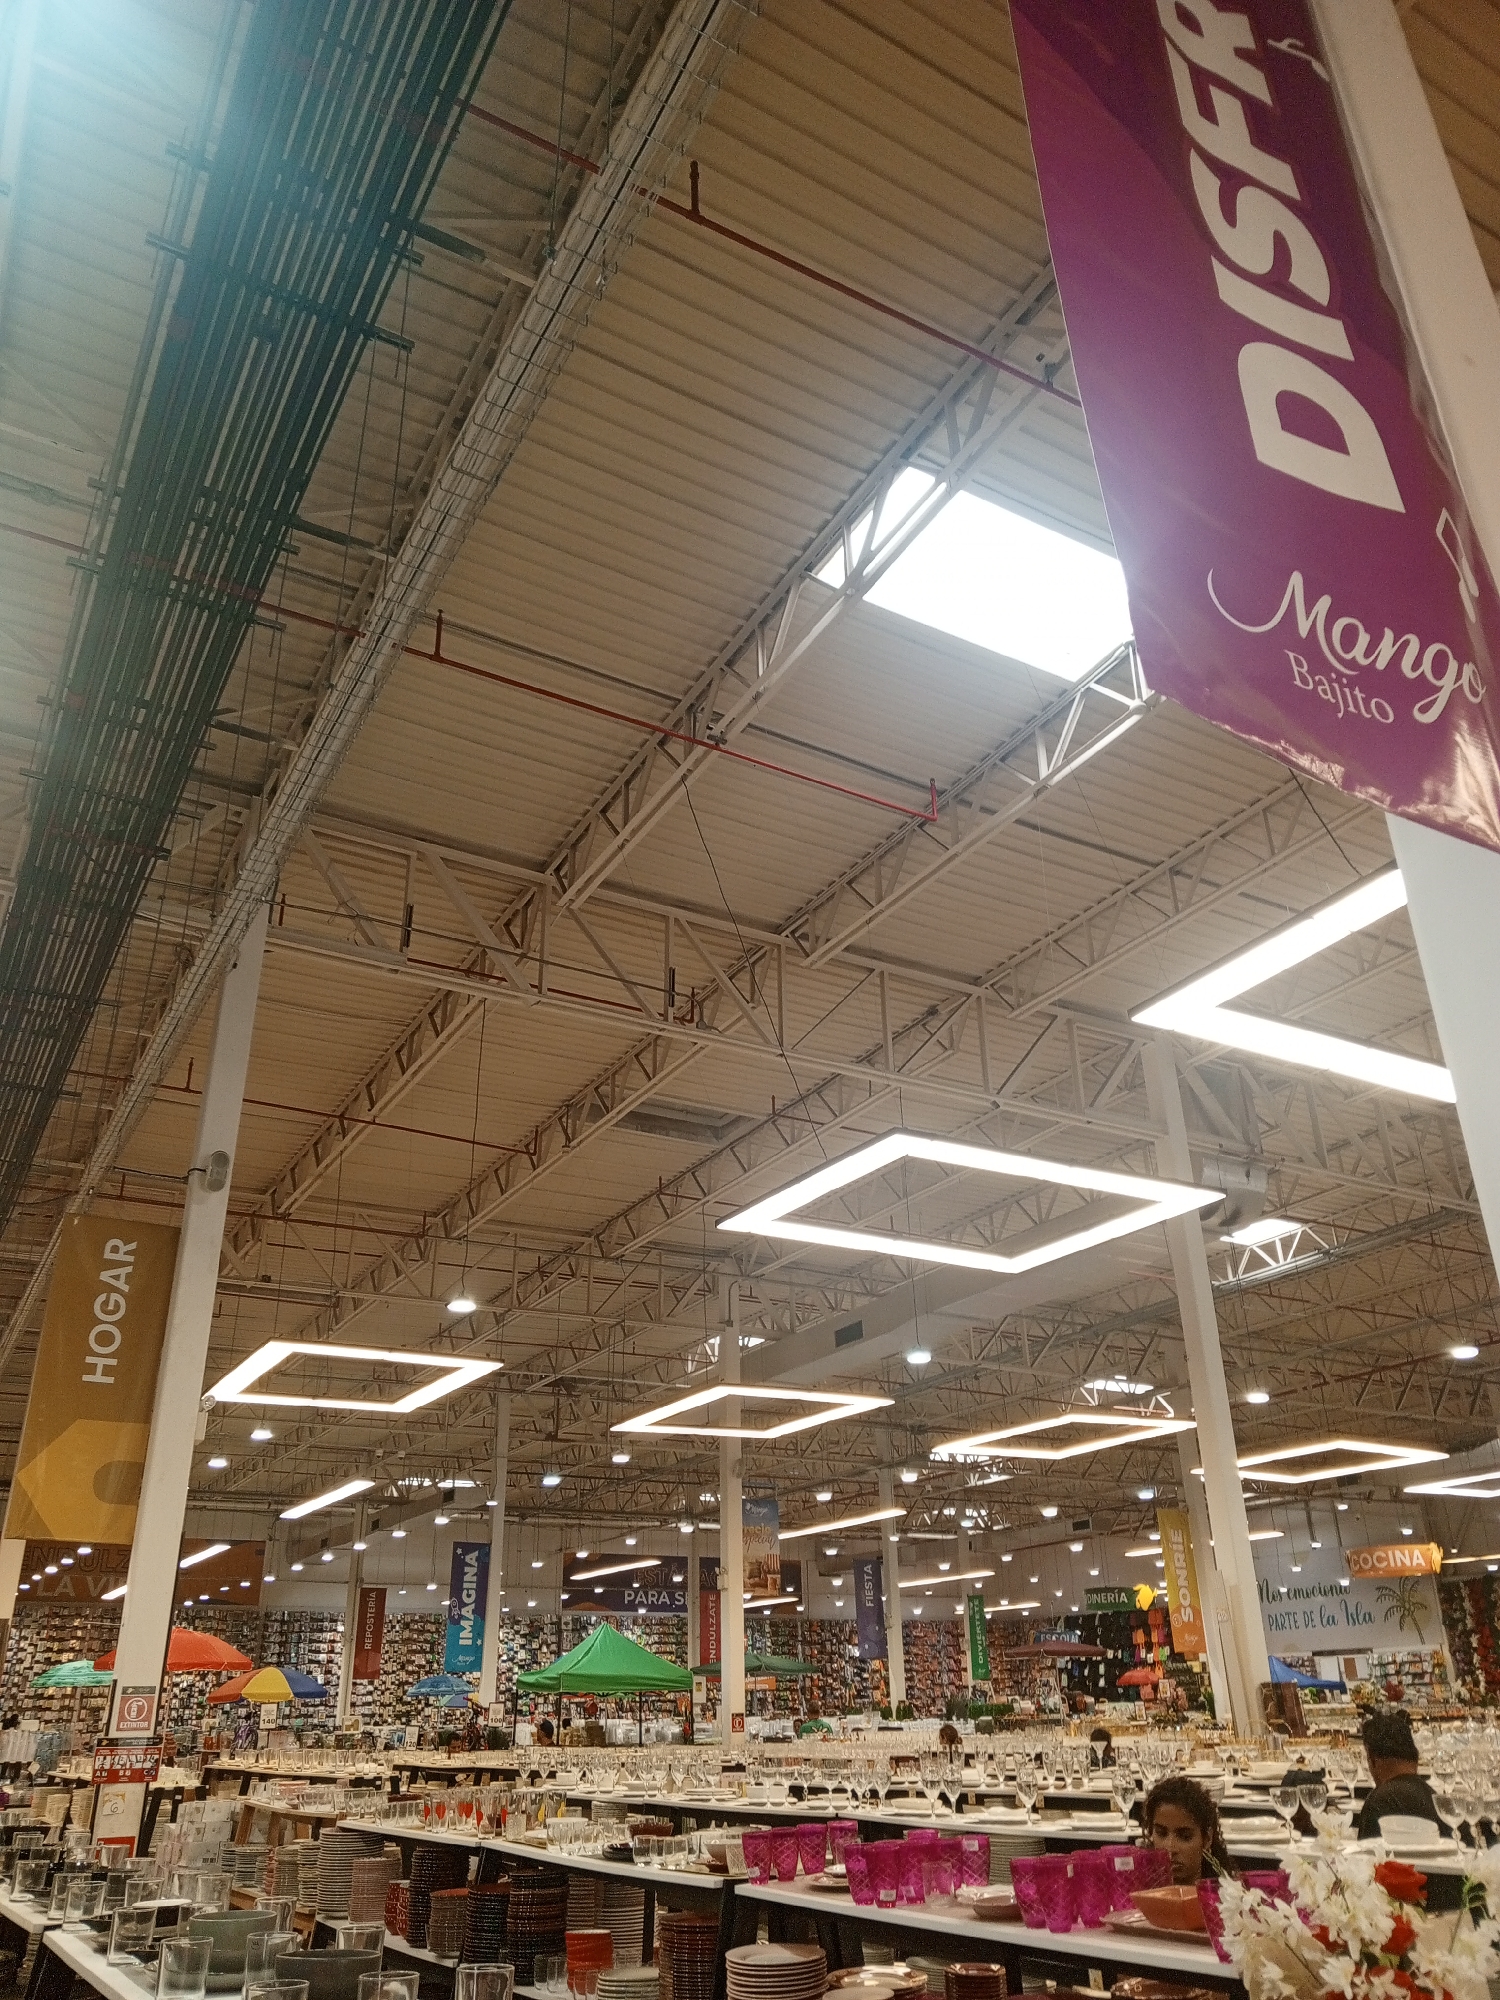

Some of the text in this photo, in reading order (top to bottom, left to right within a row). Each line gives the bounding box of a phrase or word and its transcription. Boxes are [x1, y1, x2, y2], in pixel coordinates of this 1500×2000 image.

[1207, 570, 1487, 723] Mango
[1283, 649, 1395, 723] Bajito
[81, 1237, 138, 1385] HOGAR
[1169, 1528, 1194, 1623] SONRÍE
[1350, 1549, 1426, 1571] COCINA
[459, 1550, 479, 1645] IMAGINA
[624, 1590, 670, 1605] PARA
[863, 1564, 874, 1607] FIESTA
[1257, 1578, 1351, 1604] Nos emociona
[364, 1591, 377, 1650] REPOSTERÍA
[1268, 1598, 1375, 1631] PARTE DE la Isla
[119, 1721, 149, 1729] EXTINTOR
[110, 1801, 119, 1814] 6
